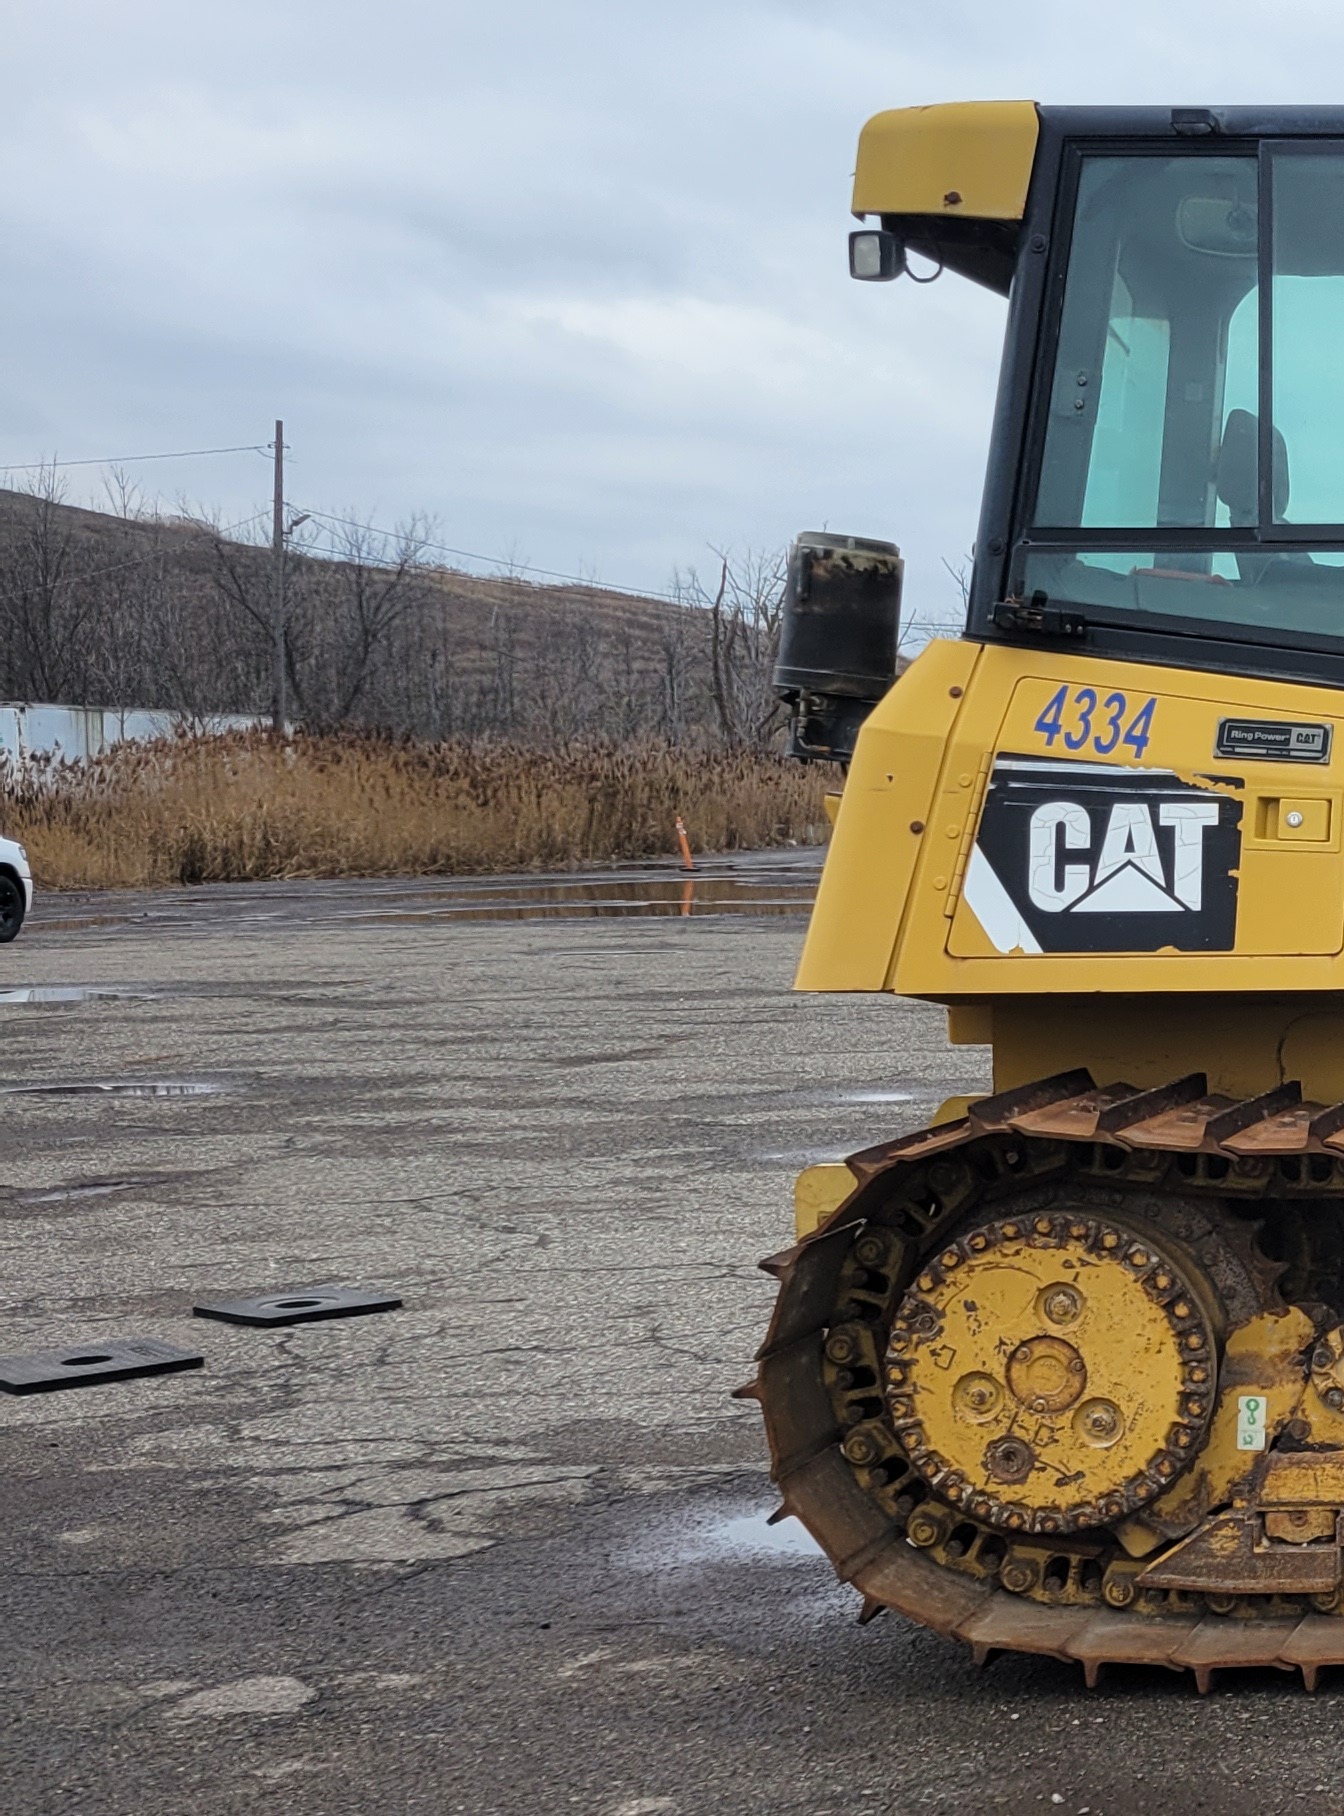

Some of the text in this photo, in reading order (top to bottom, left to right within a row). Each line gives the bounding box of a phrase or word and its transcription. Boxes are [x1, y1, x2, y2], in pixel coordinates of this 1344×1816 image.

[1035, 684, 1158, 759] 4334
[1230, 730, 1287, 742] Ring Power
[1296, 732, 1317, 744] CAT
[1028, 801, 1220, 913] CAT
